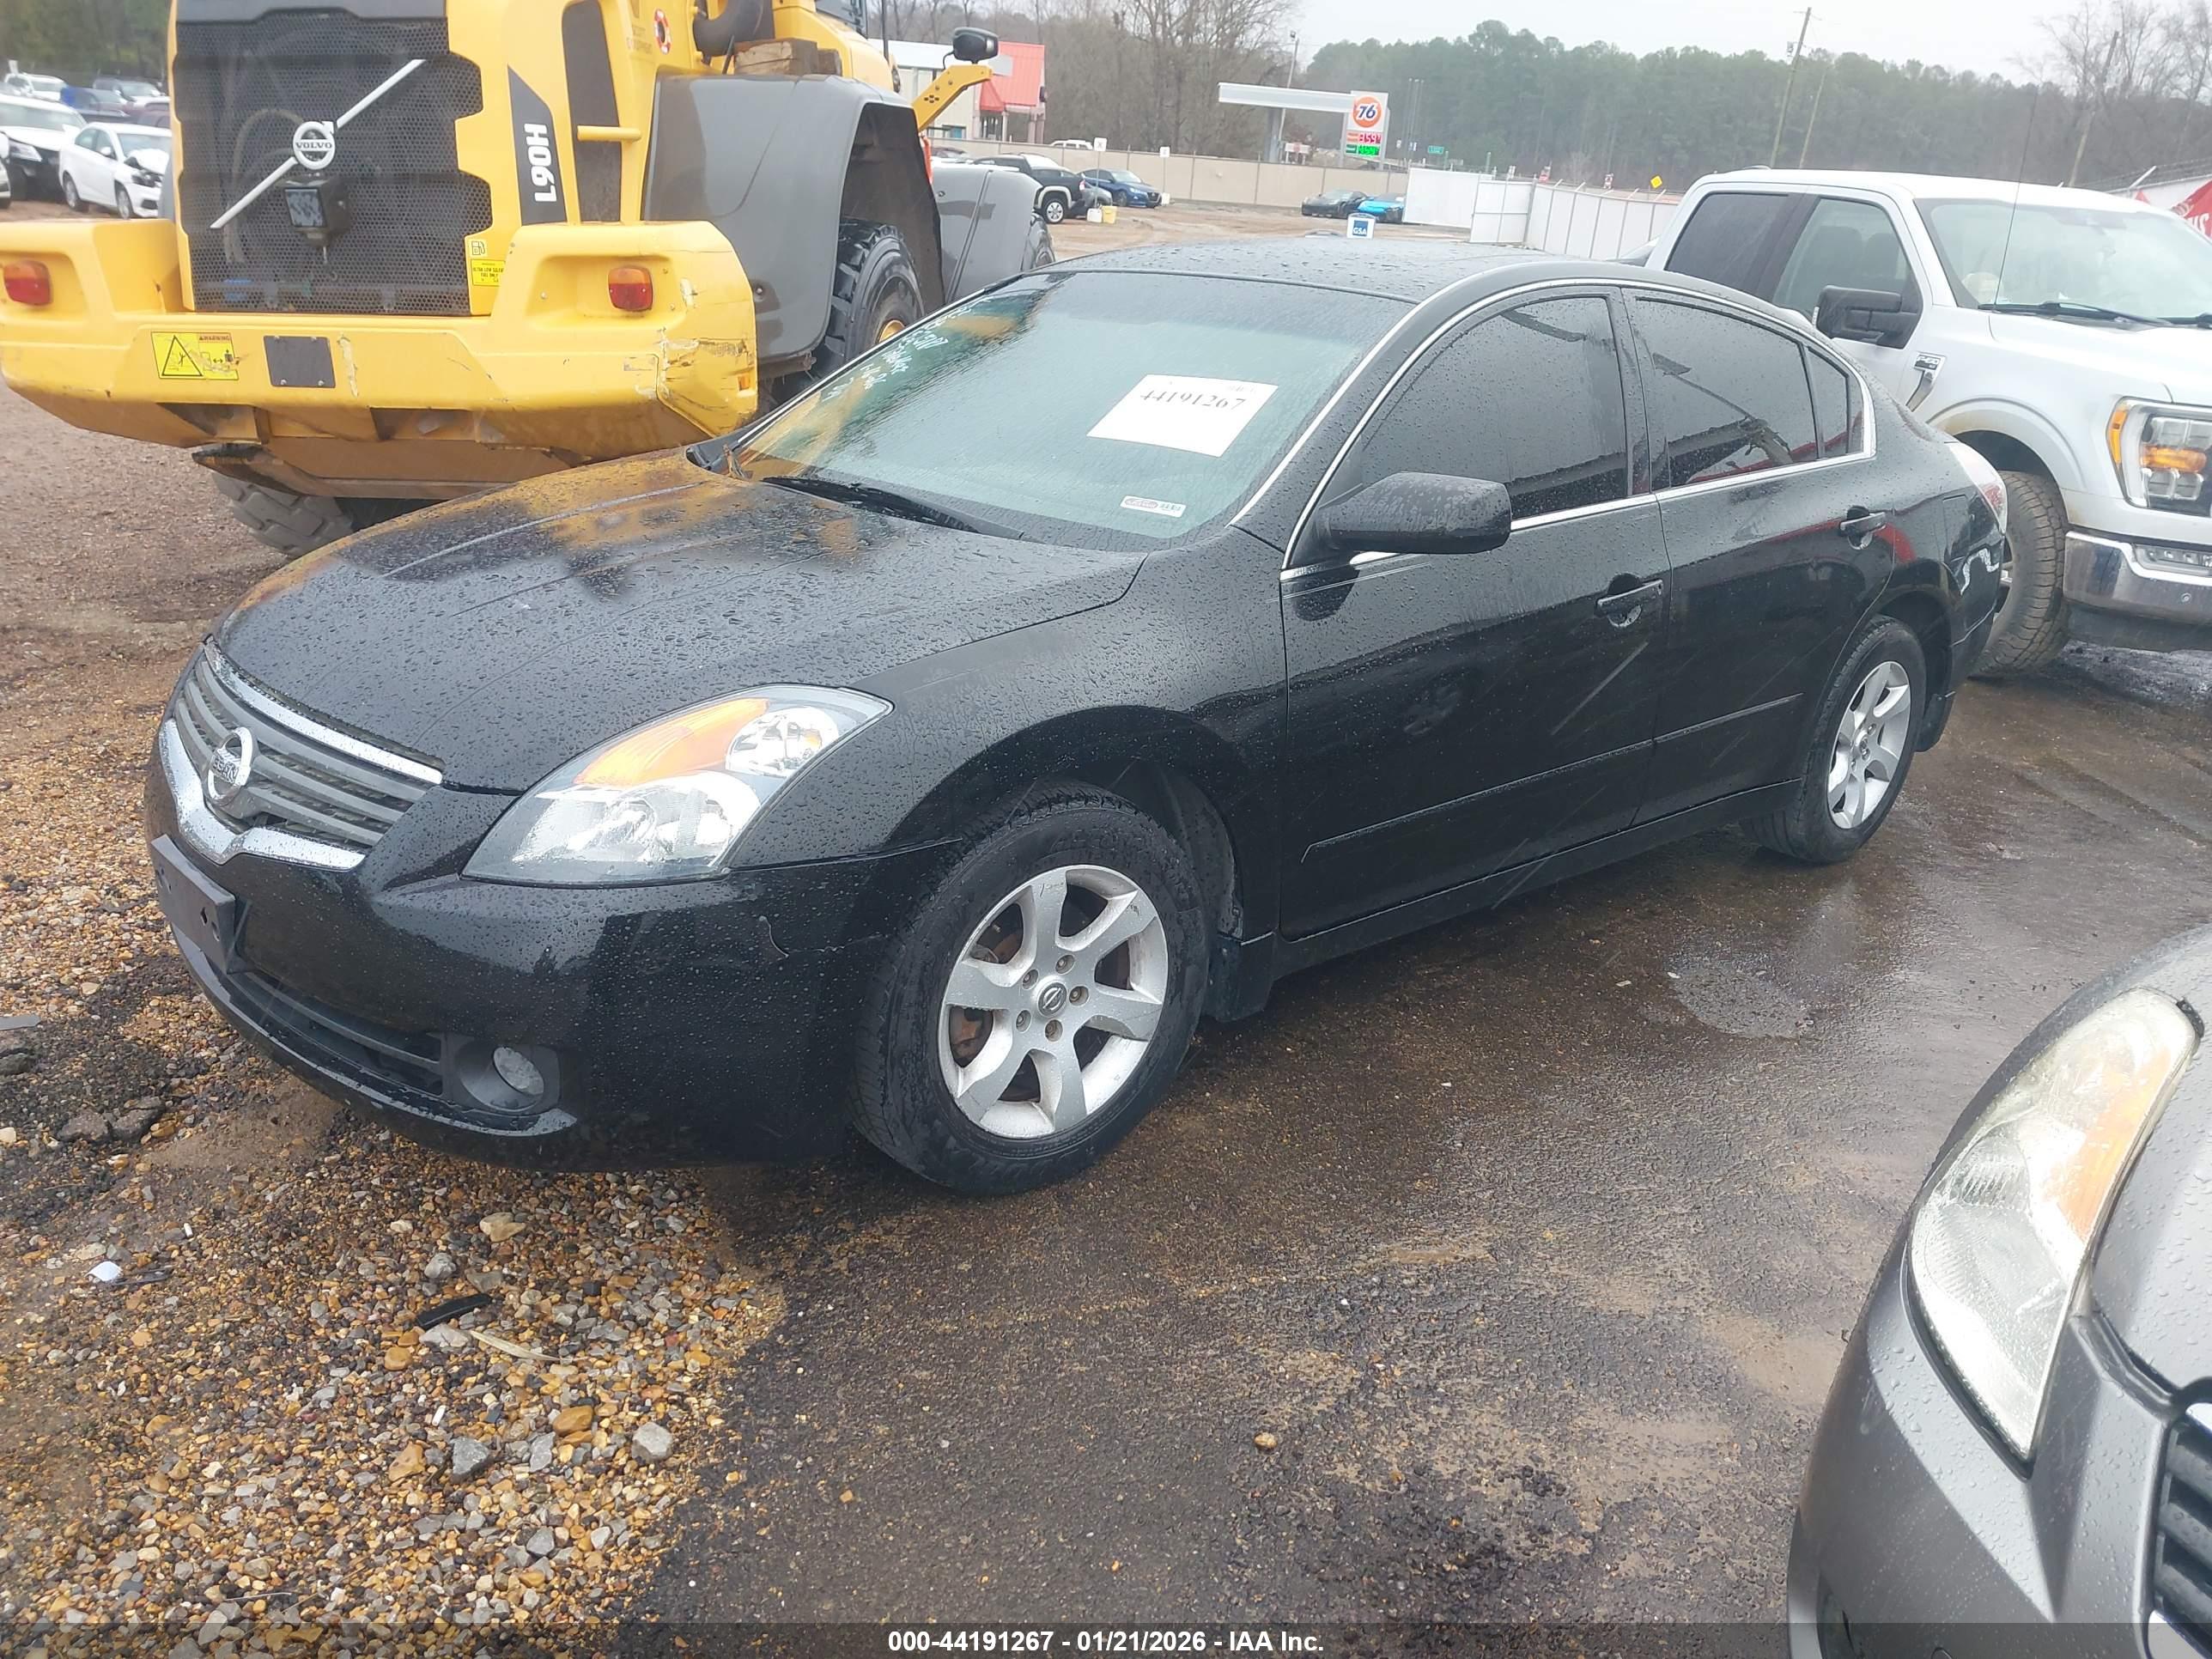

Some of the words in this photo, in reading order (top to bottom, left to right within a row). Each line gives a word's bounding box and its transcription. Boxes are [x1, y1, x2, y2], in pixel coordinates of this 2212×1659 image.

[1358, 105, 1376, 118] 76
[524, 123, 557, 202] L90H
[1140, 390, 1246, 410] 44191267
[210, 755, 240, 783] SSAN
